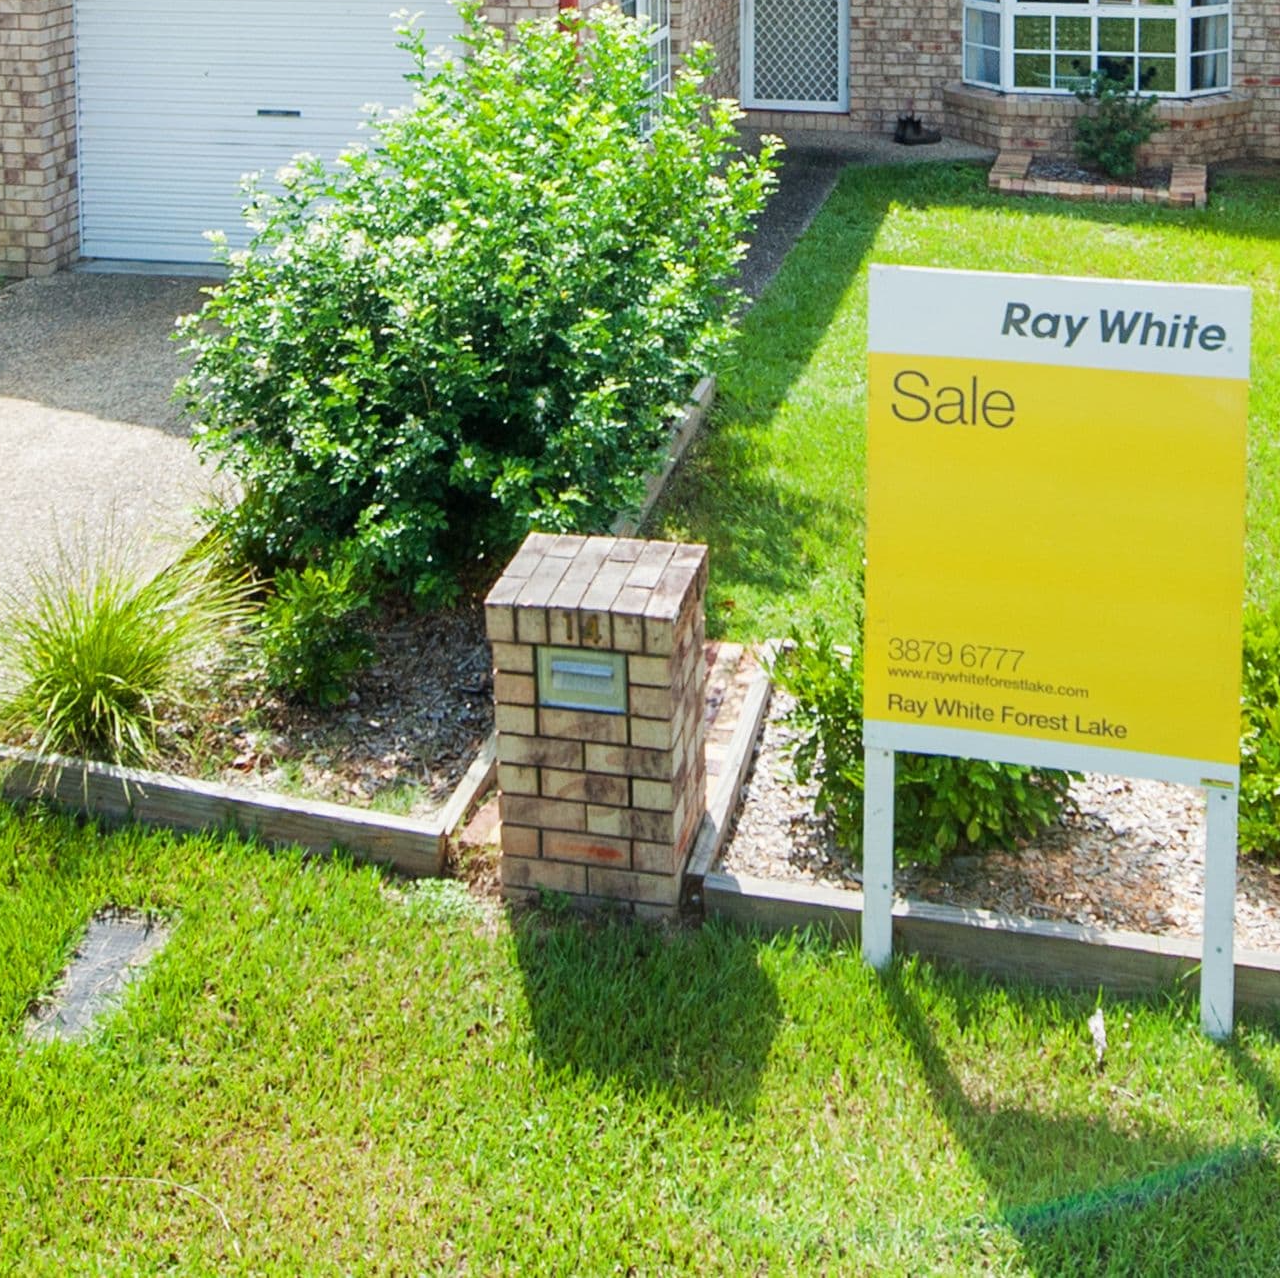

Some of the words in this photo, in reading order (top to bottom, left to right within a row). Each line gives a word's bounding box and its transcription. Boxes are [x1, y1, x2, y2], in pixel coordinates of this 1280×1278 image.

[1001, 302, 1089, 347] Ray
[1100, 308, 1226, 352] White
[891, 370, 1016, 428] Sale
[888, 637, 953, 665] 3879
[960, 644, 1024, 672] 6777
[888, 666, 1089, 699] www.raywhiteforestlake.com
[888, 693, 928, 717] Ray
[934, 698, 995, 722] White
[1001, 706, 1068, 732] Forest
[1075, 715, 1127, 739] Lake
